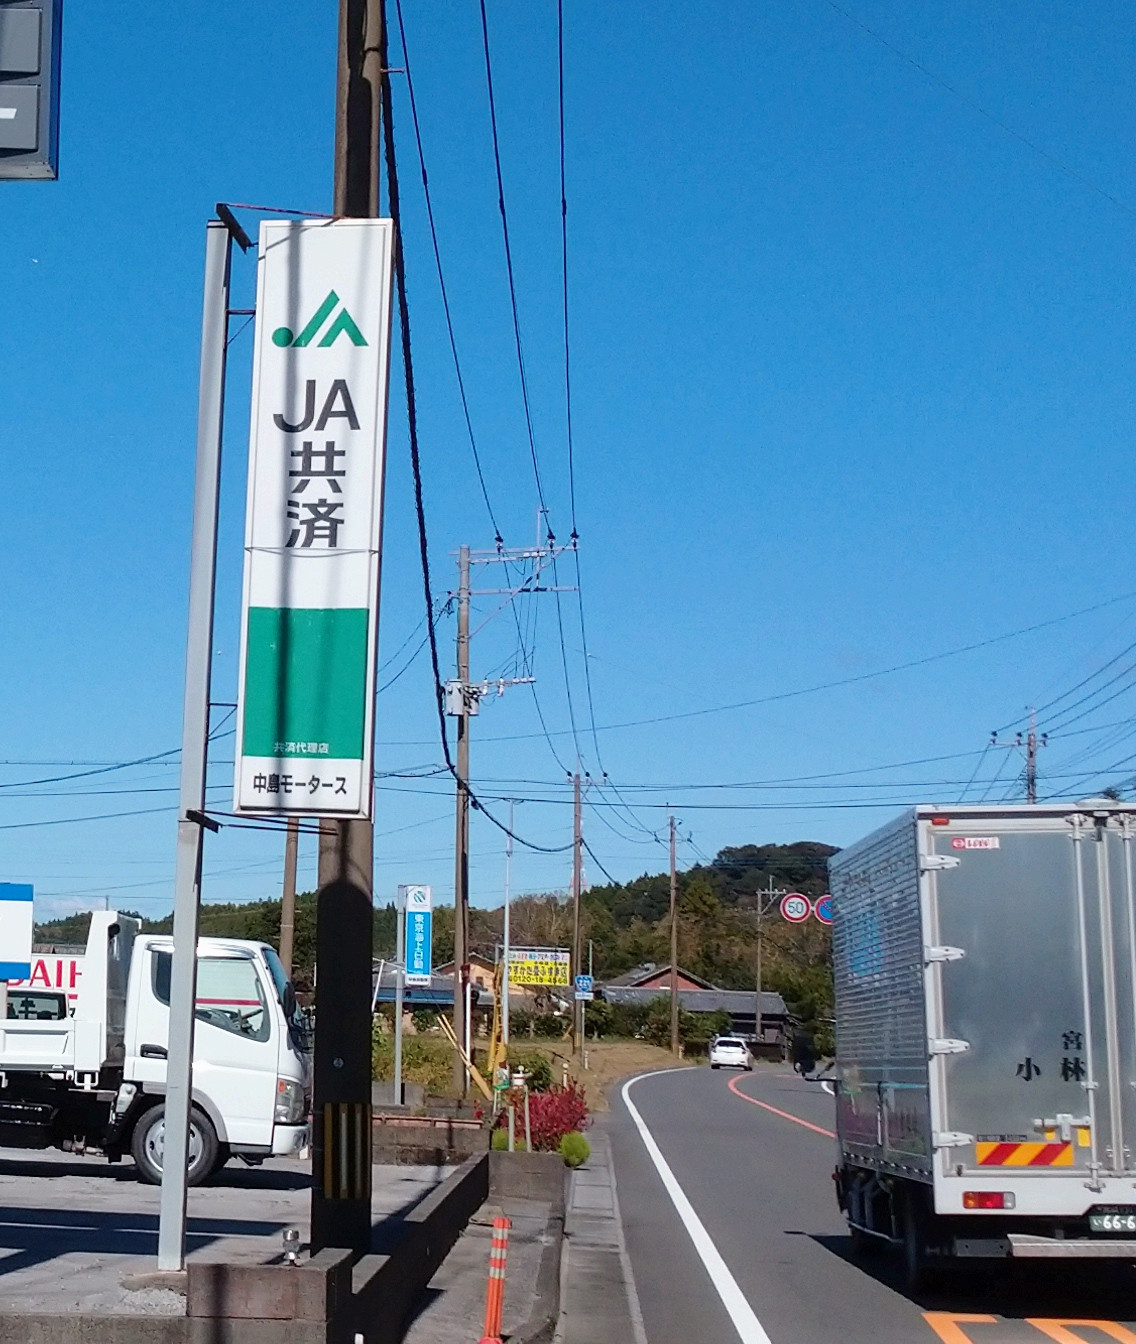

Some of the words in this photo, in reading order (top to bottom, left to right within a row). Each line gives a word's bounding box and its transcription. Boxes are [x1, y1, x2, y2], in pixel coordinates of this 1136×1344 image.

[273, 741, 330, 754] 共済代理店
[253, 772, 347, 795] 中島モータース
[787, 901, 805, 914] 50
